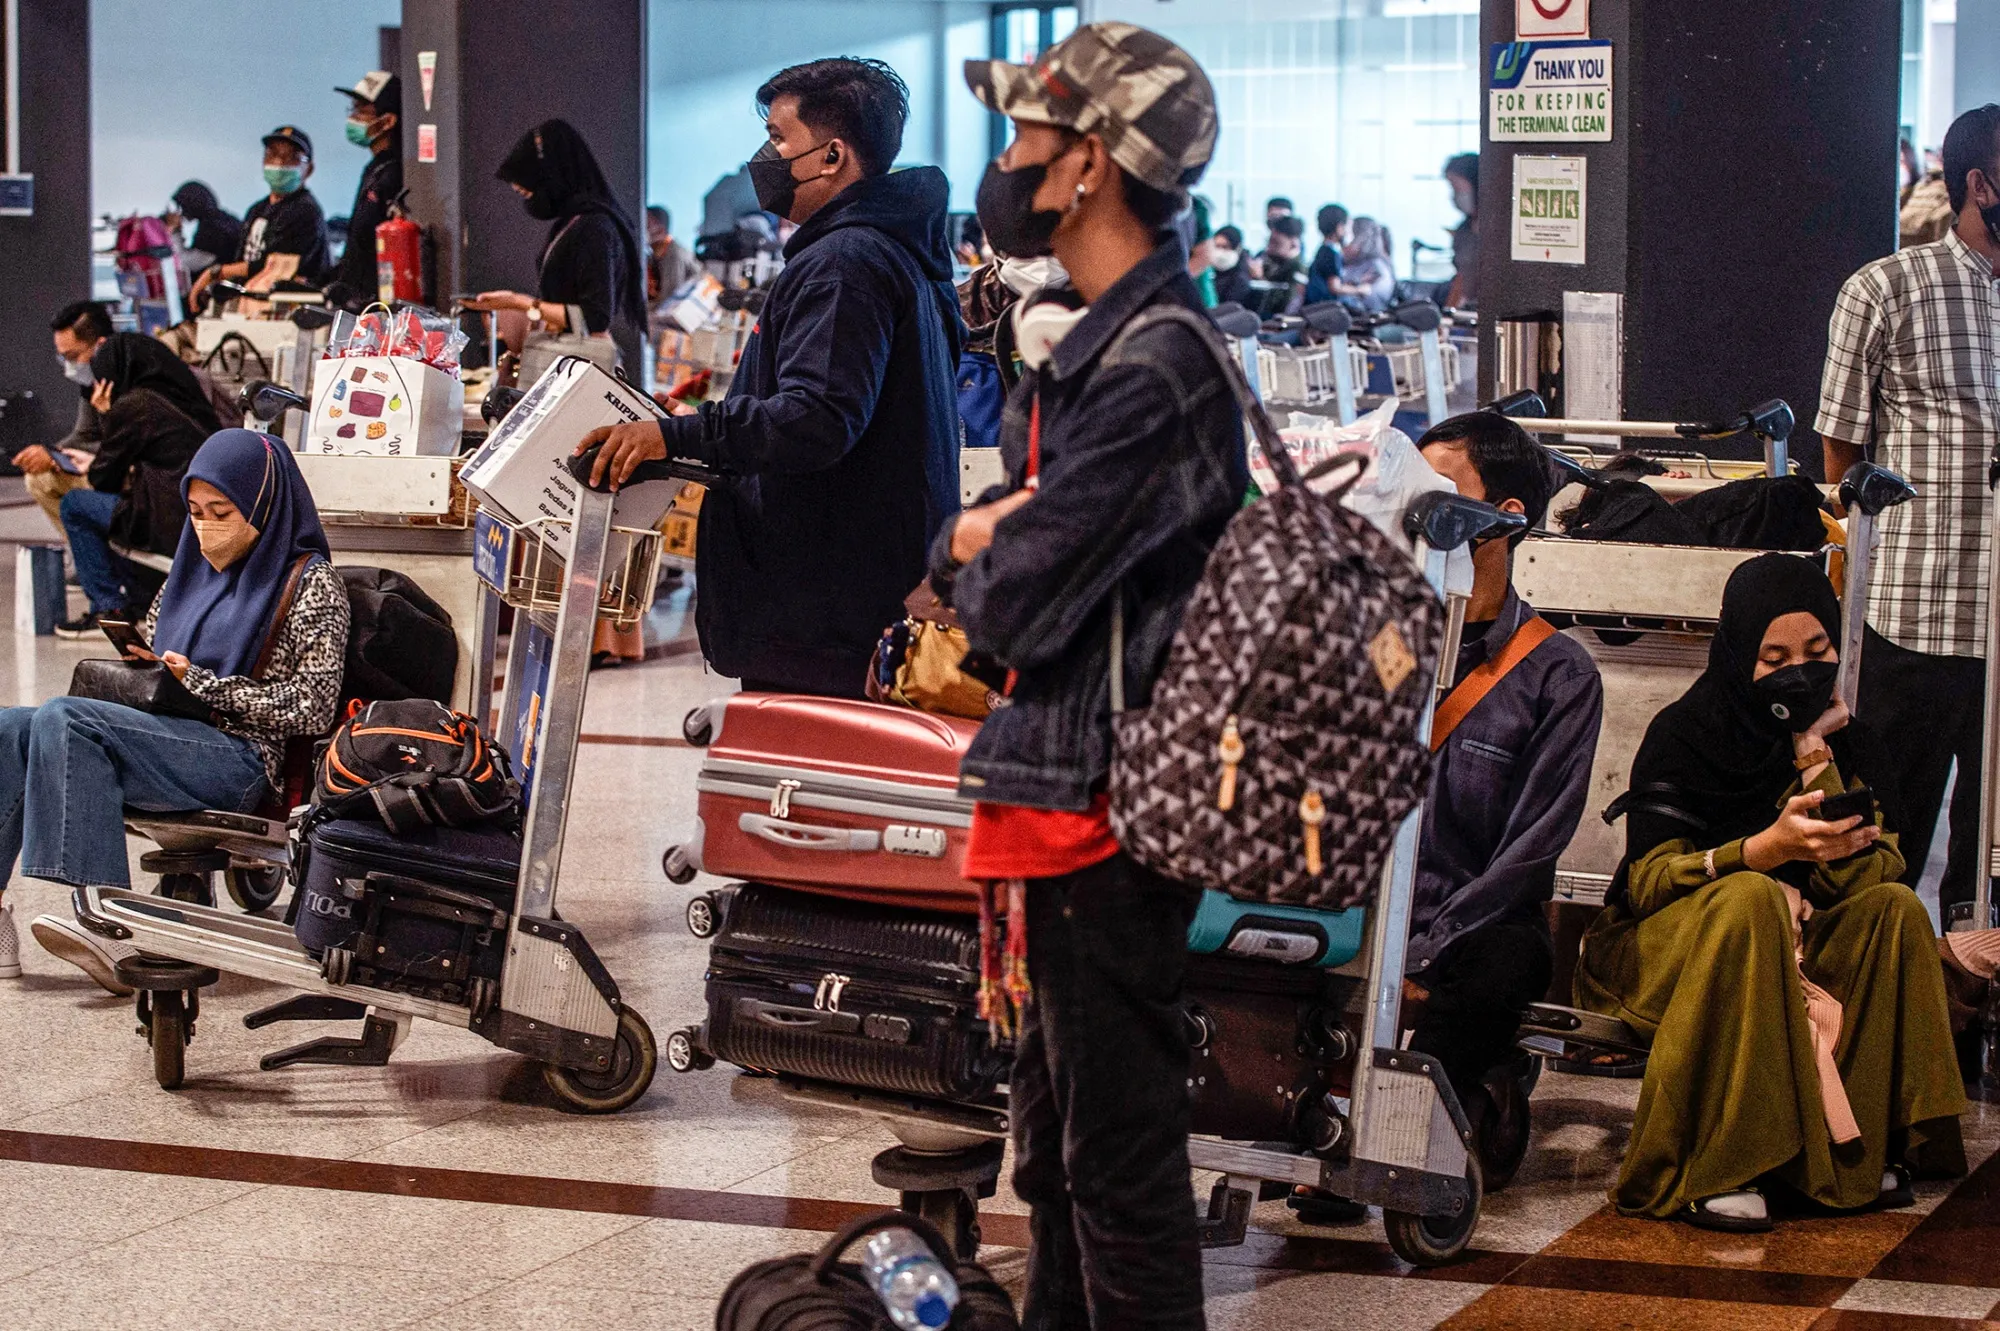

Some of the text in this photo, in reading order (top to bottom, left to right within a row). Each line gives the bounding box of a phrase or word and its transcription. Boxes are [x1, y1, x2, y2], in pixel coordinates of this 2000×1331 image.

[1534, 58, 1604, 80] THANK YOU
[1497, 92, 1605, 111] FOR KEEPING
[1497, 115, 1605, 133] THE TERMINAL CLEAN
[604, 391, 642, 422] KRIPIK
[543, 487, 568, 511] Pedas
